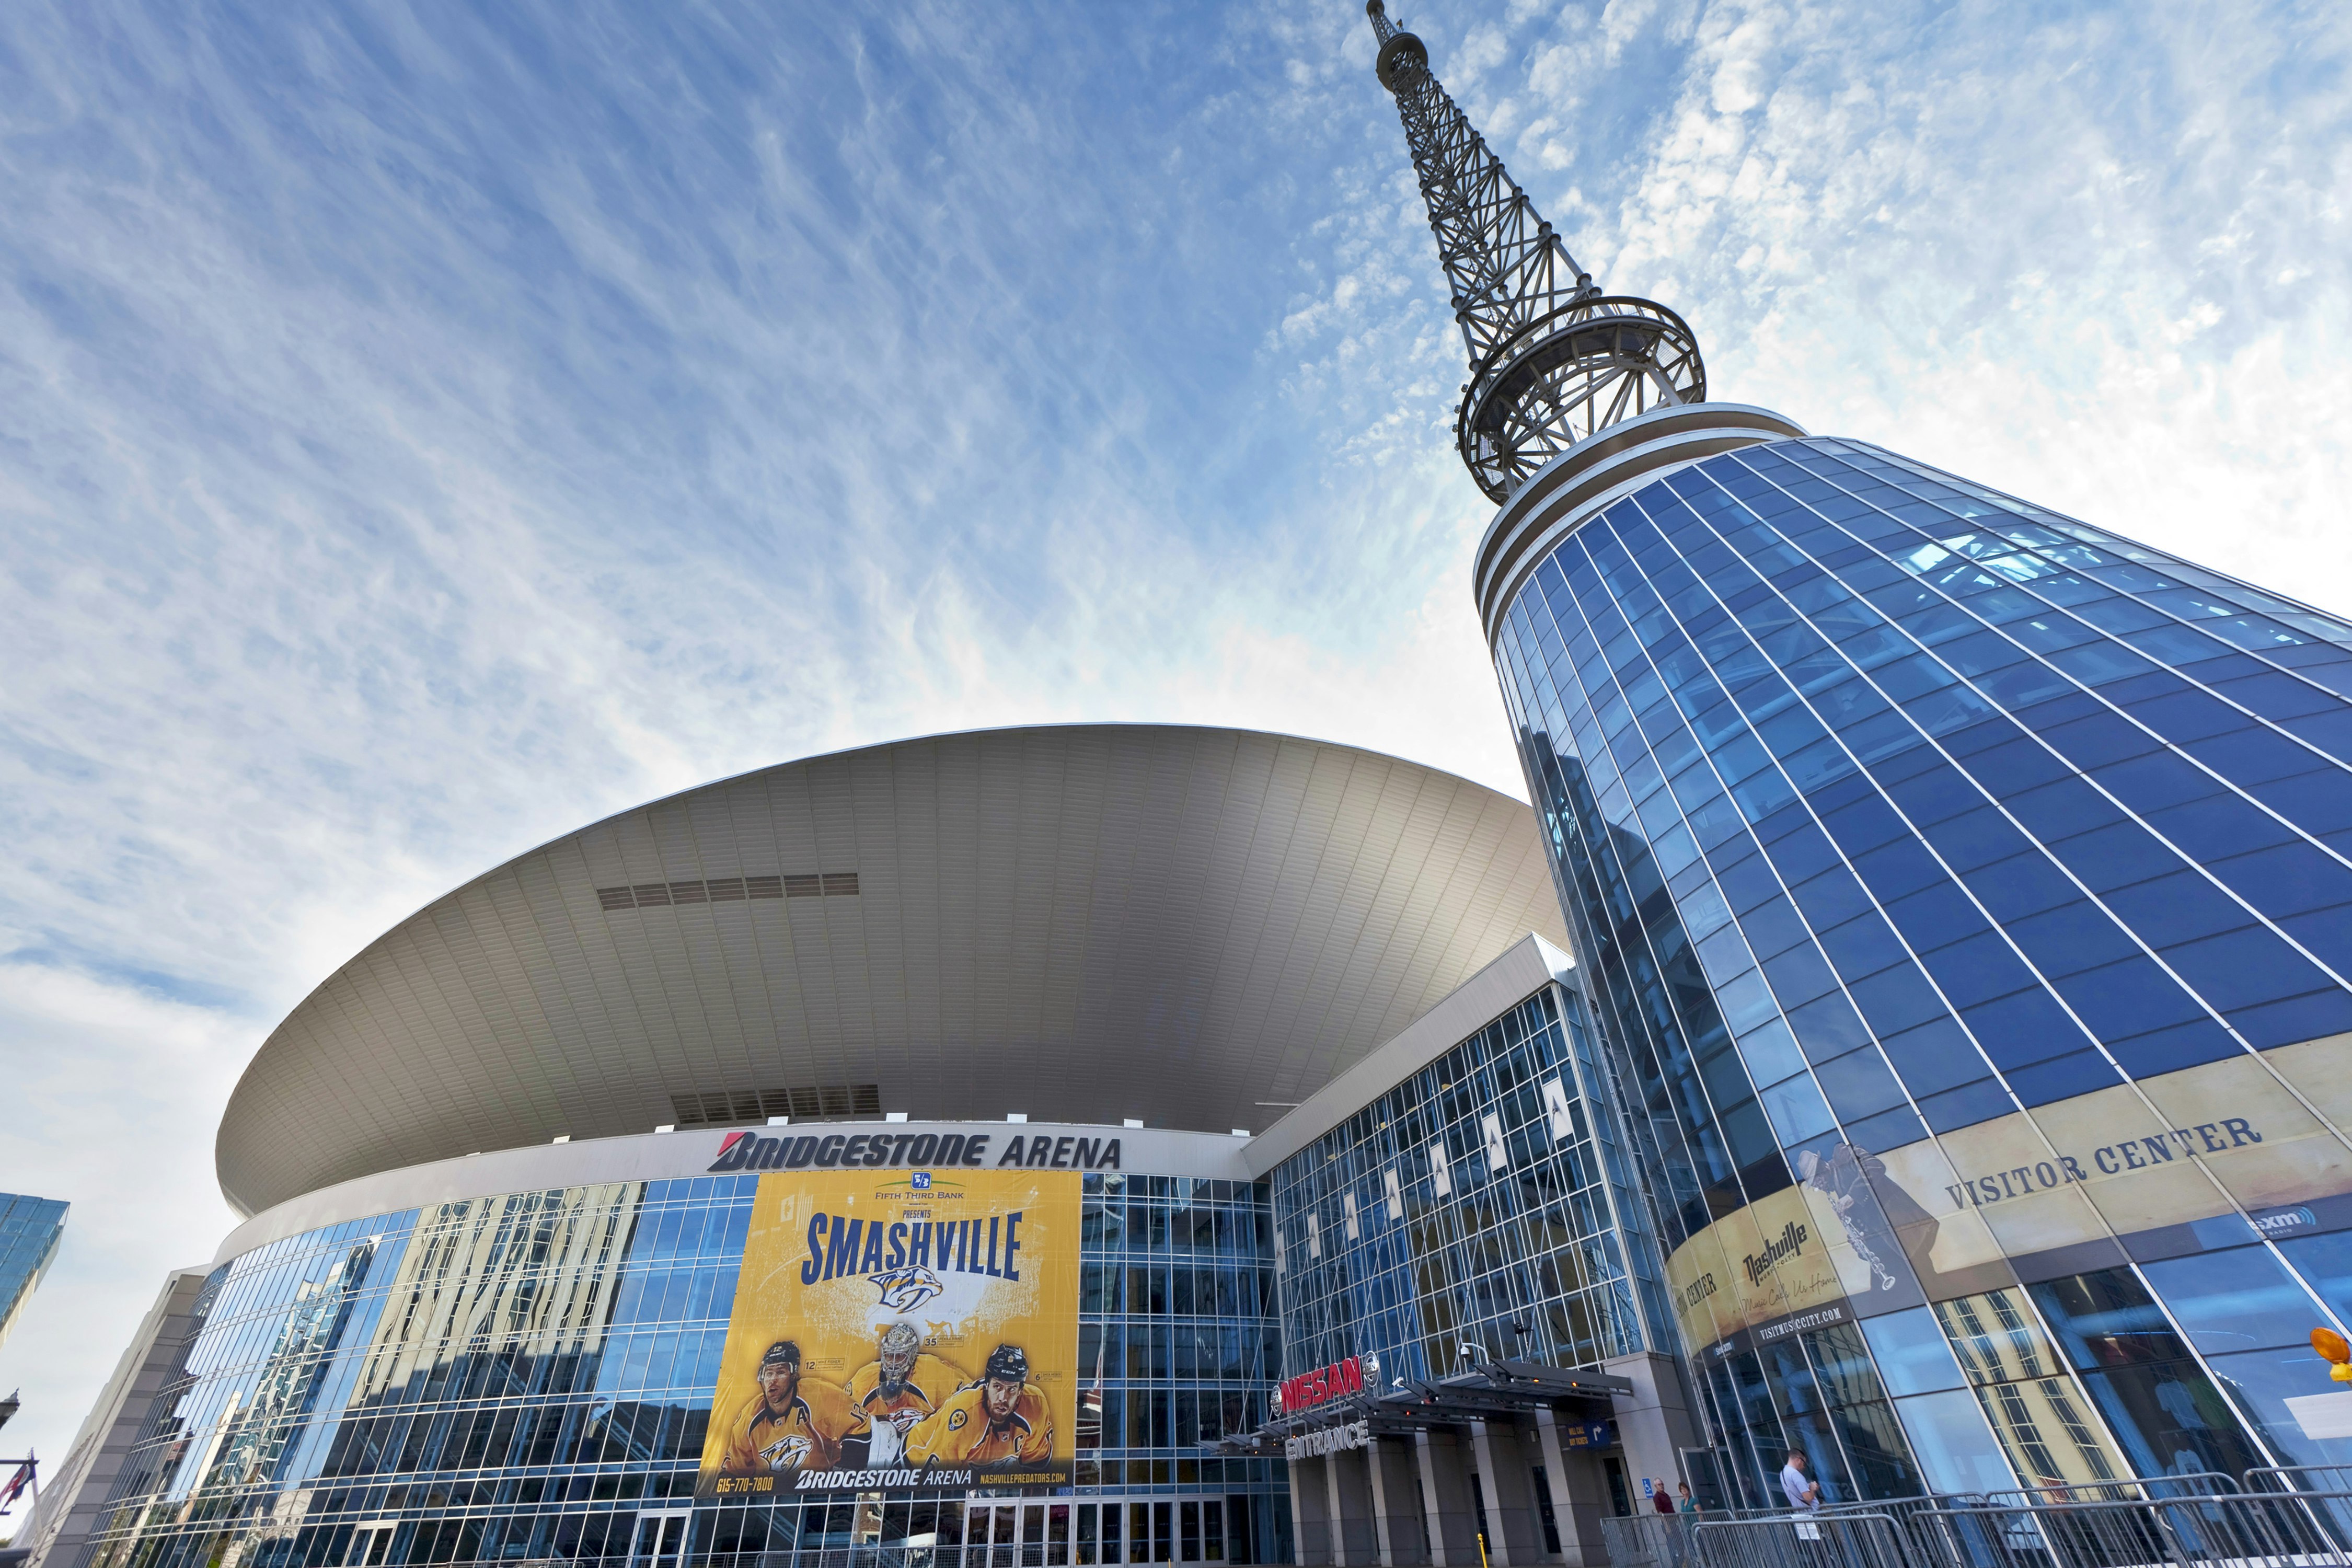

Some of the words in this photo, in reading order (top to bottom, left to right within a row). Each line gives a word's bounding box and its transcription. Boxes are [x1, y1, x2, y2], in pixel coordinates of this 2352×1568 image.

[707, 1132, 990, 1172] BRIDGESTONE
[998, 1135, 1121, 1169] ARENA
[1944, 1156, 2088, 1210] VISITOR
[2093, 1117, 2262, 1175] CENTER
[903, 1209, 931, 1219] PRESENTS
[801, 1211, 1023, 1285] SMASHVILLE
[1743, 1221, 1807, 1287] Nashville
[1780, 1252, 1795, 1265] CITY
[1686, 1272, 1717, 1307] CENTER
[1793, 1280, 1807, 1297] Us
[1809, 1273, 1837, 1295] Home
[925, 1338, 937, 1346] 35
[805, 1362, 815, 1370] 12
[1281, 1354, 1363, 1414] NISSAN
[795, 1406, 809, 1426] A
[1013, 1434, 1024, 1456] C
[1285, 1420, 1370, 1461] ENTRANCE
[717, 1477, 774, 1493] 615-770-7800
[794, 1468, 921, 1490] BRIDGESTONE
[923, 1469, 972, 1485] ARENA
[980, 1472, 1066, 1485] NASHVILLEPREDATORS.COM
